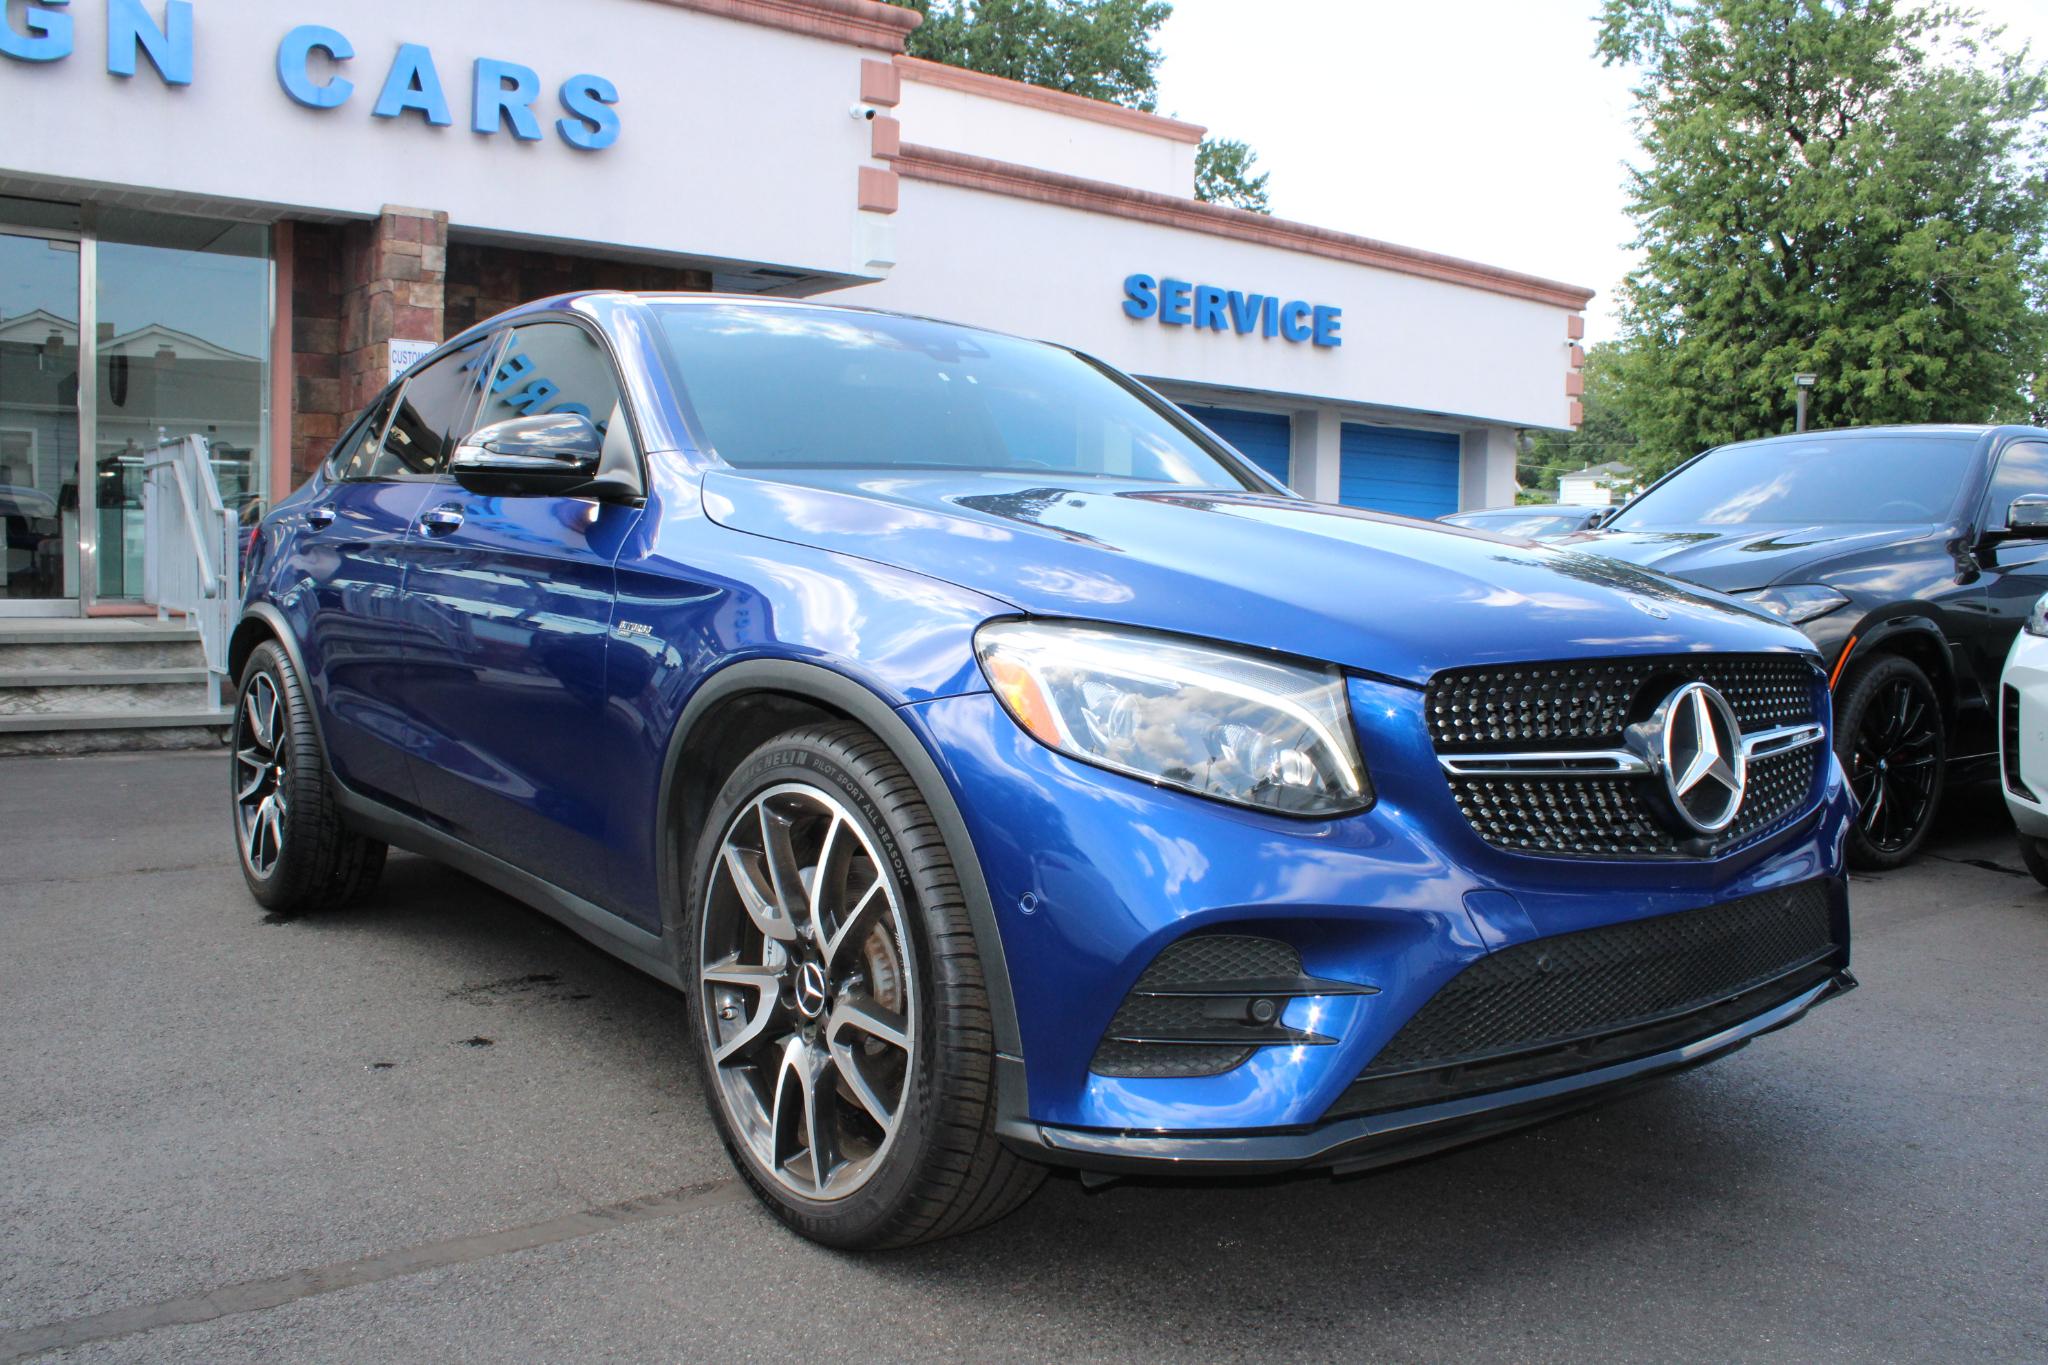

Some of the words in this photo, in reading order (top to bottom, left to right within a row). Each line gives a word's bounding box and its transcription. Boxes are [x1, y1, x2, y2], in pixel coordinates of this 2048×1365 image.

[276, 24, 622, 151] CARS
[1123, 273, 1342, 348] SERVICE
[812, 759, 837, 777] PILOT
[836, 773, 864, 801] SPORT
[862, 803, 880, 825] ALL
[878, 826, 906, 878] SEASON
